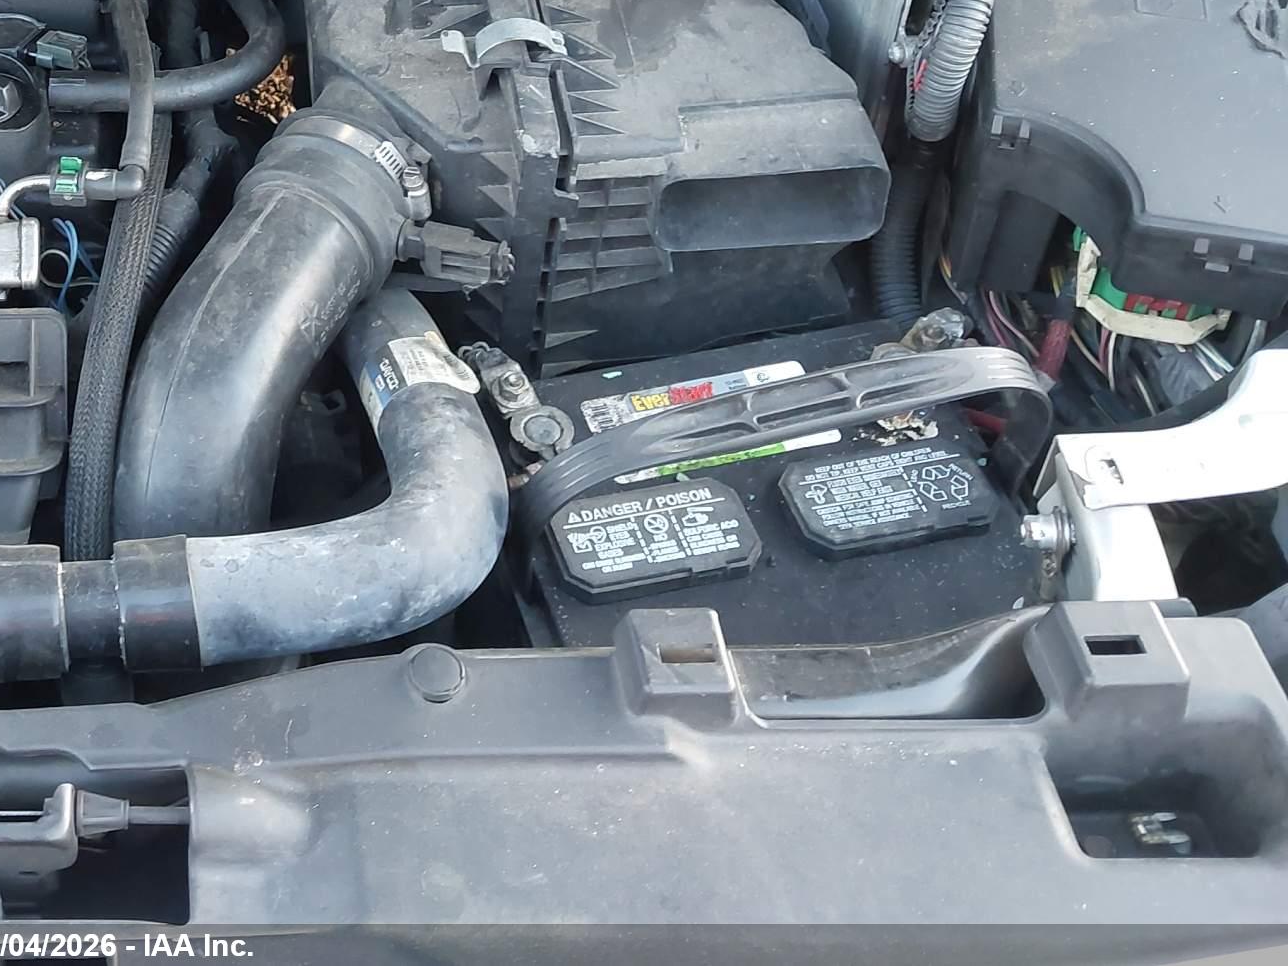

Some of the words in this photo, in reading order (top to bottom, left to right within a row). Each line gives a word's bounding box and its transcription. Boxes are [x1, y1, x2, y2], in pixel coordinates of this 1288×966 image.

[580, 500, 643, 522] DANGER
[645, 498, 653, 510] /
[655, 487, 713, 508] POISON
